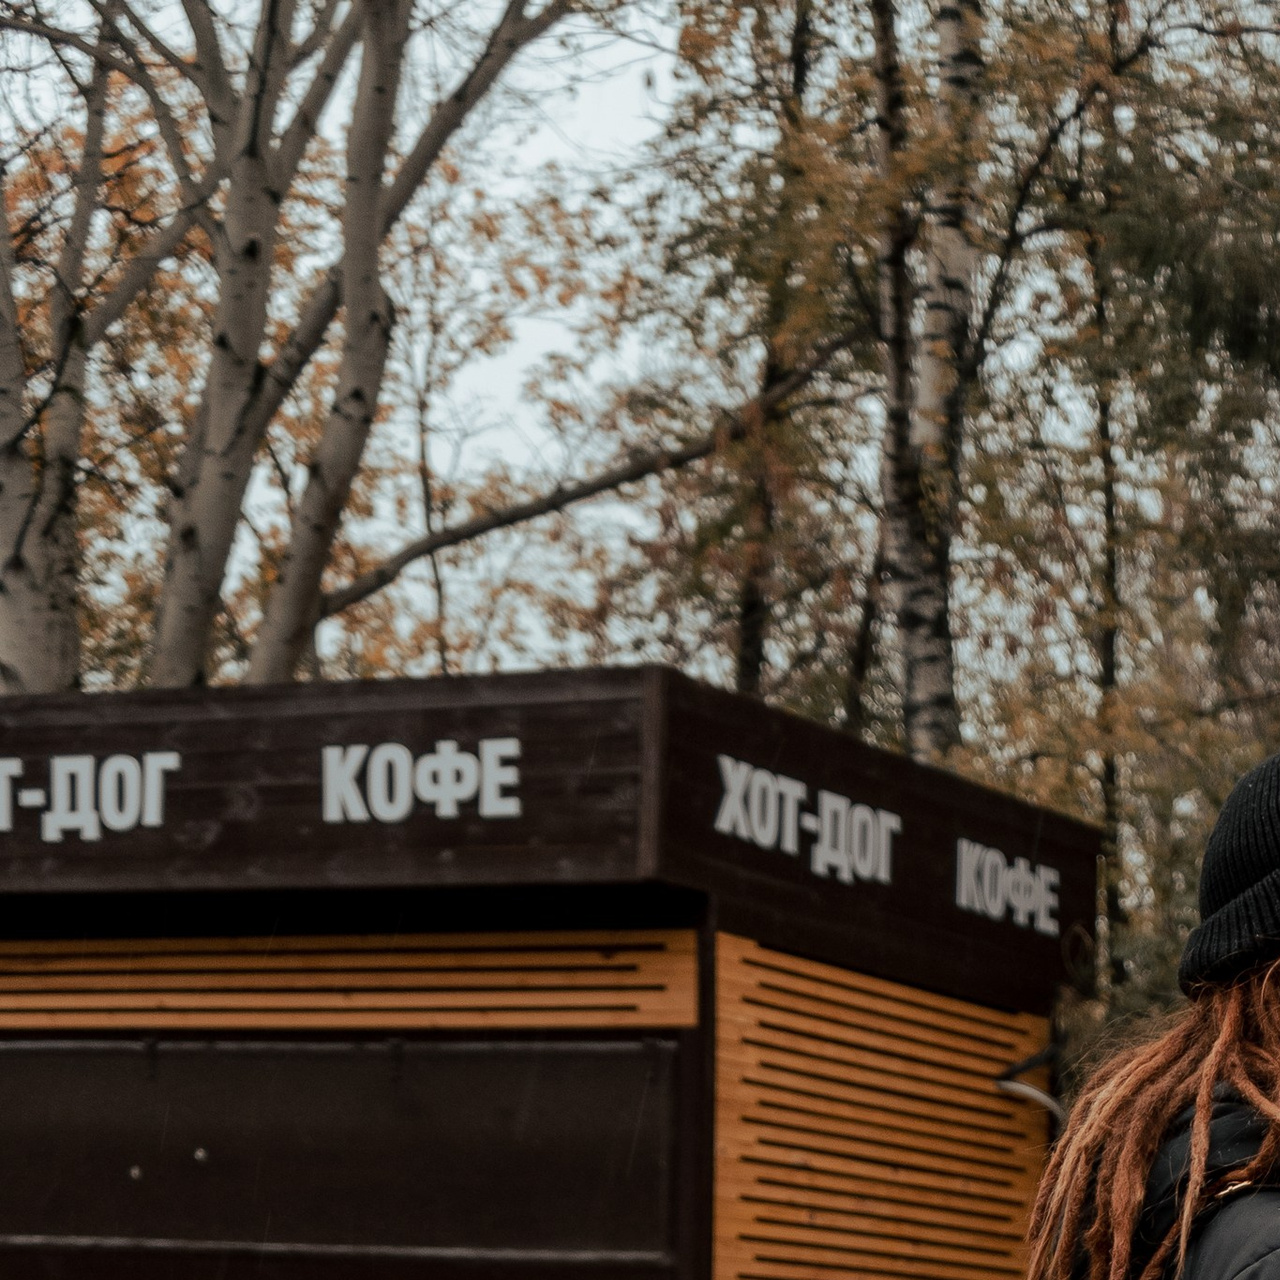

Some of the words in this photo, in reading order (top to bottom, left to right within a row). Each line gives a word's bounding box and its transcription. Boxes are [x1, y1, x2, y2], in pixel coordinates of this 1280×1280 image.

[321, 737, 523, 823] КОФЕ
[714, 753, 903, 885] ХОТ-ДОГ
[955, 837, 1060, 937] КОФЕ
